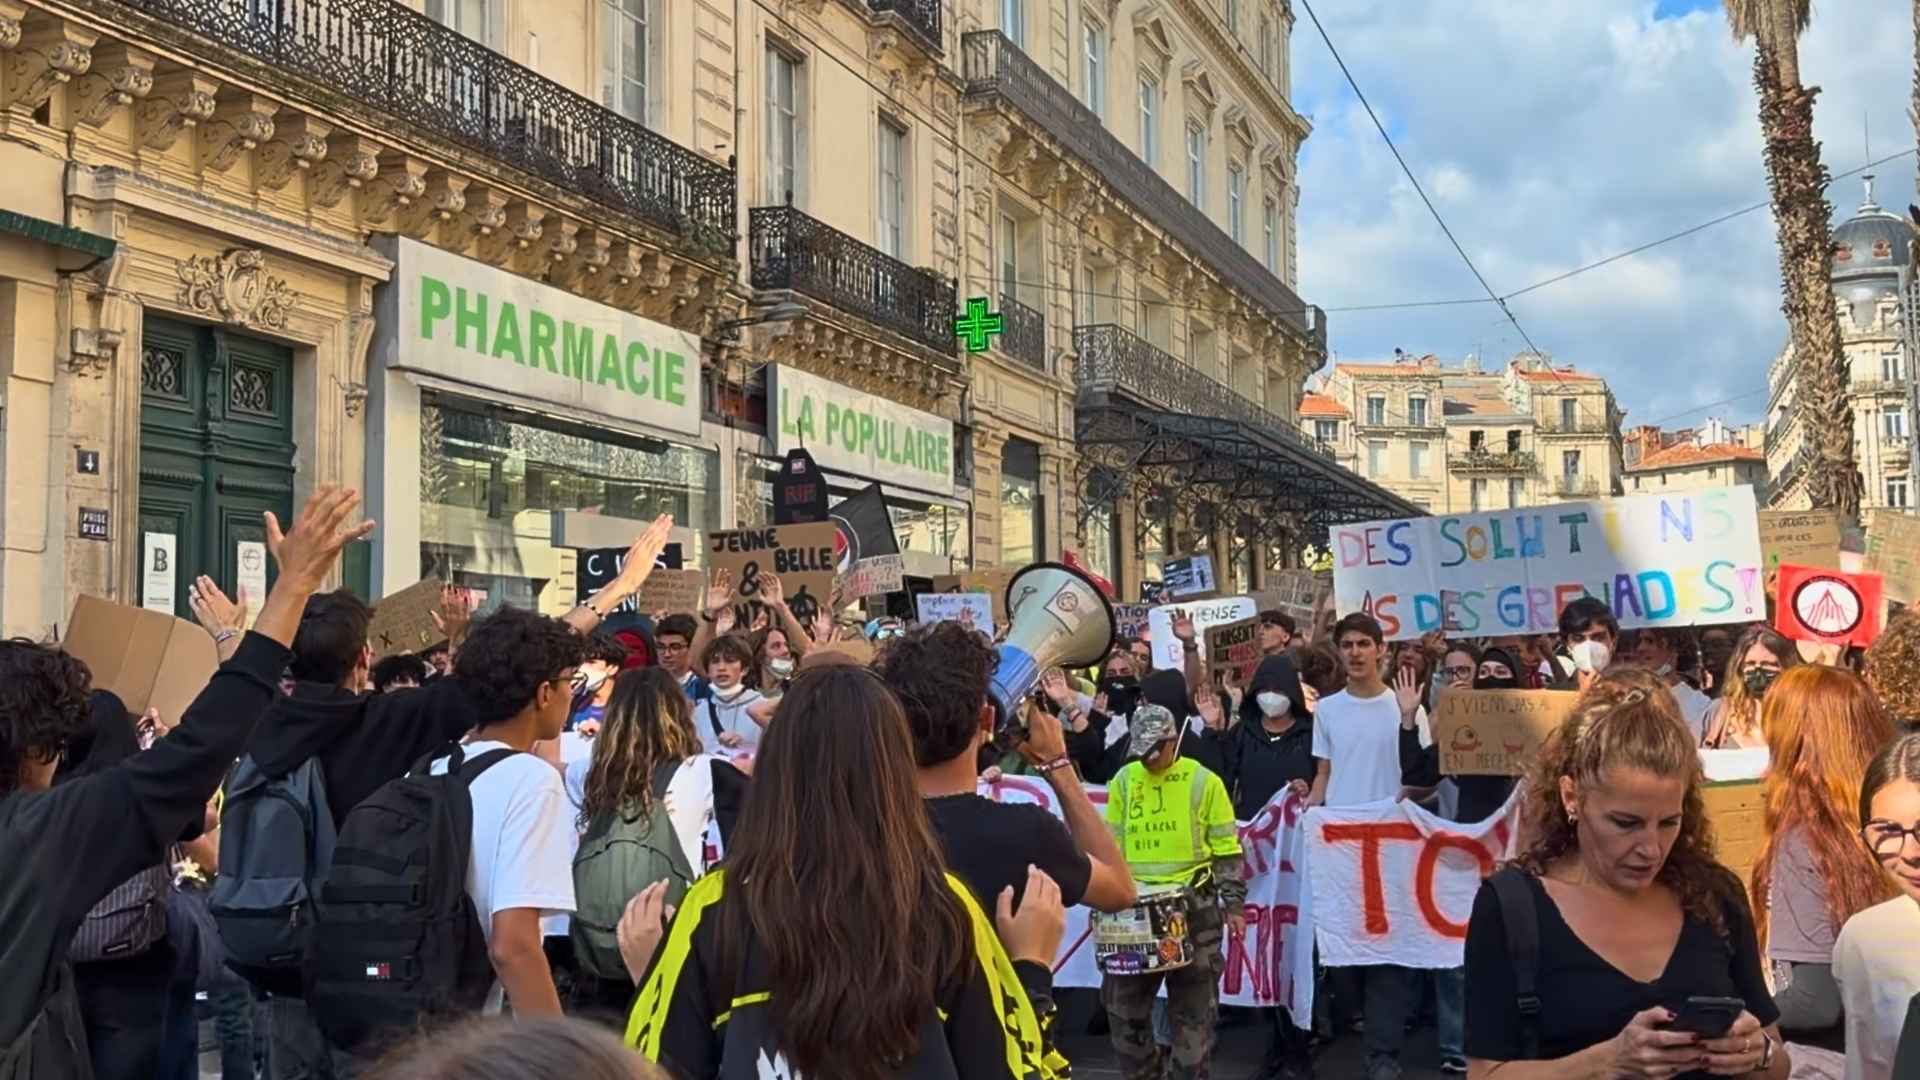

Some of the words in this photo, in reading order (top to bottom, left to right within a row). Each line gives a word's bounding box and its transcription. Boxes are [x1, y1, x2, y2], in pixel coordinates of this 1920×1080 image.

[421, 276, 686, 406] PHARMACIE
[782, 388, 816, 442] LA
[826, 402, 950, 475] POPULAIRE
[709, 528, 779, 553] JEUNE
[1339, 522, 1412, 568] DES
[1440, 490, 1735, 568] SOLUTINS
[153, 547, 168, 572] B
[739, 561, 761, 597] &
[774, 547, 833, 573] BELLE
[1413, 588, 1485, 632] DES
